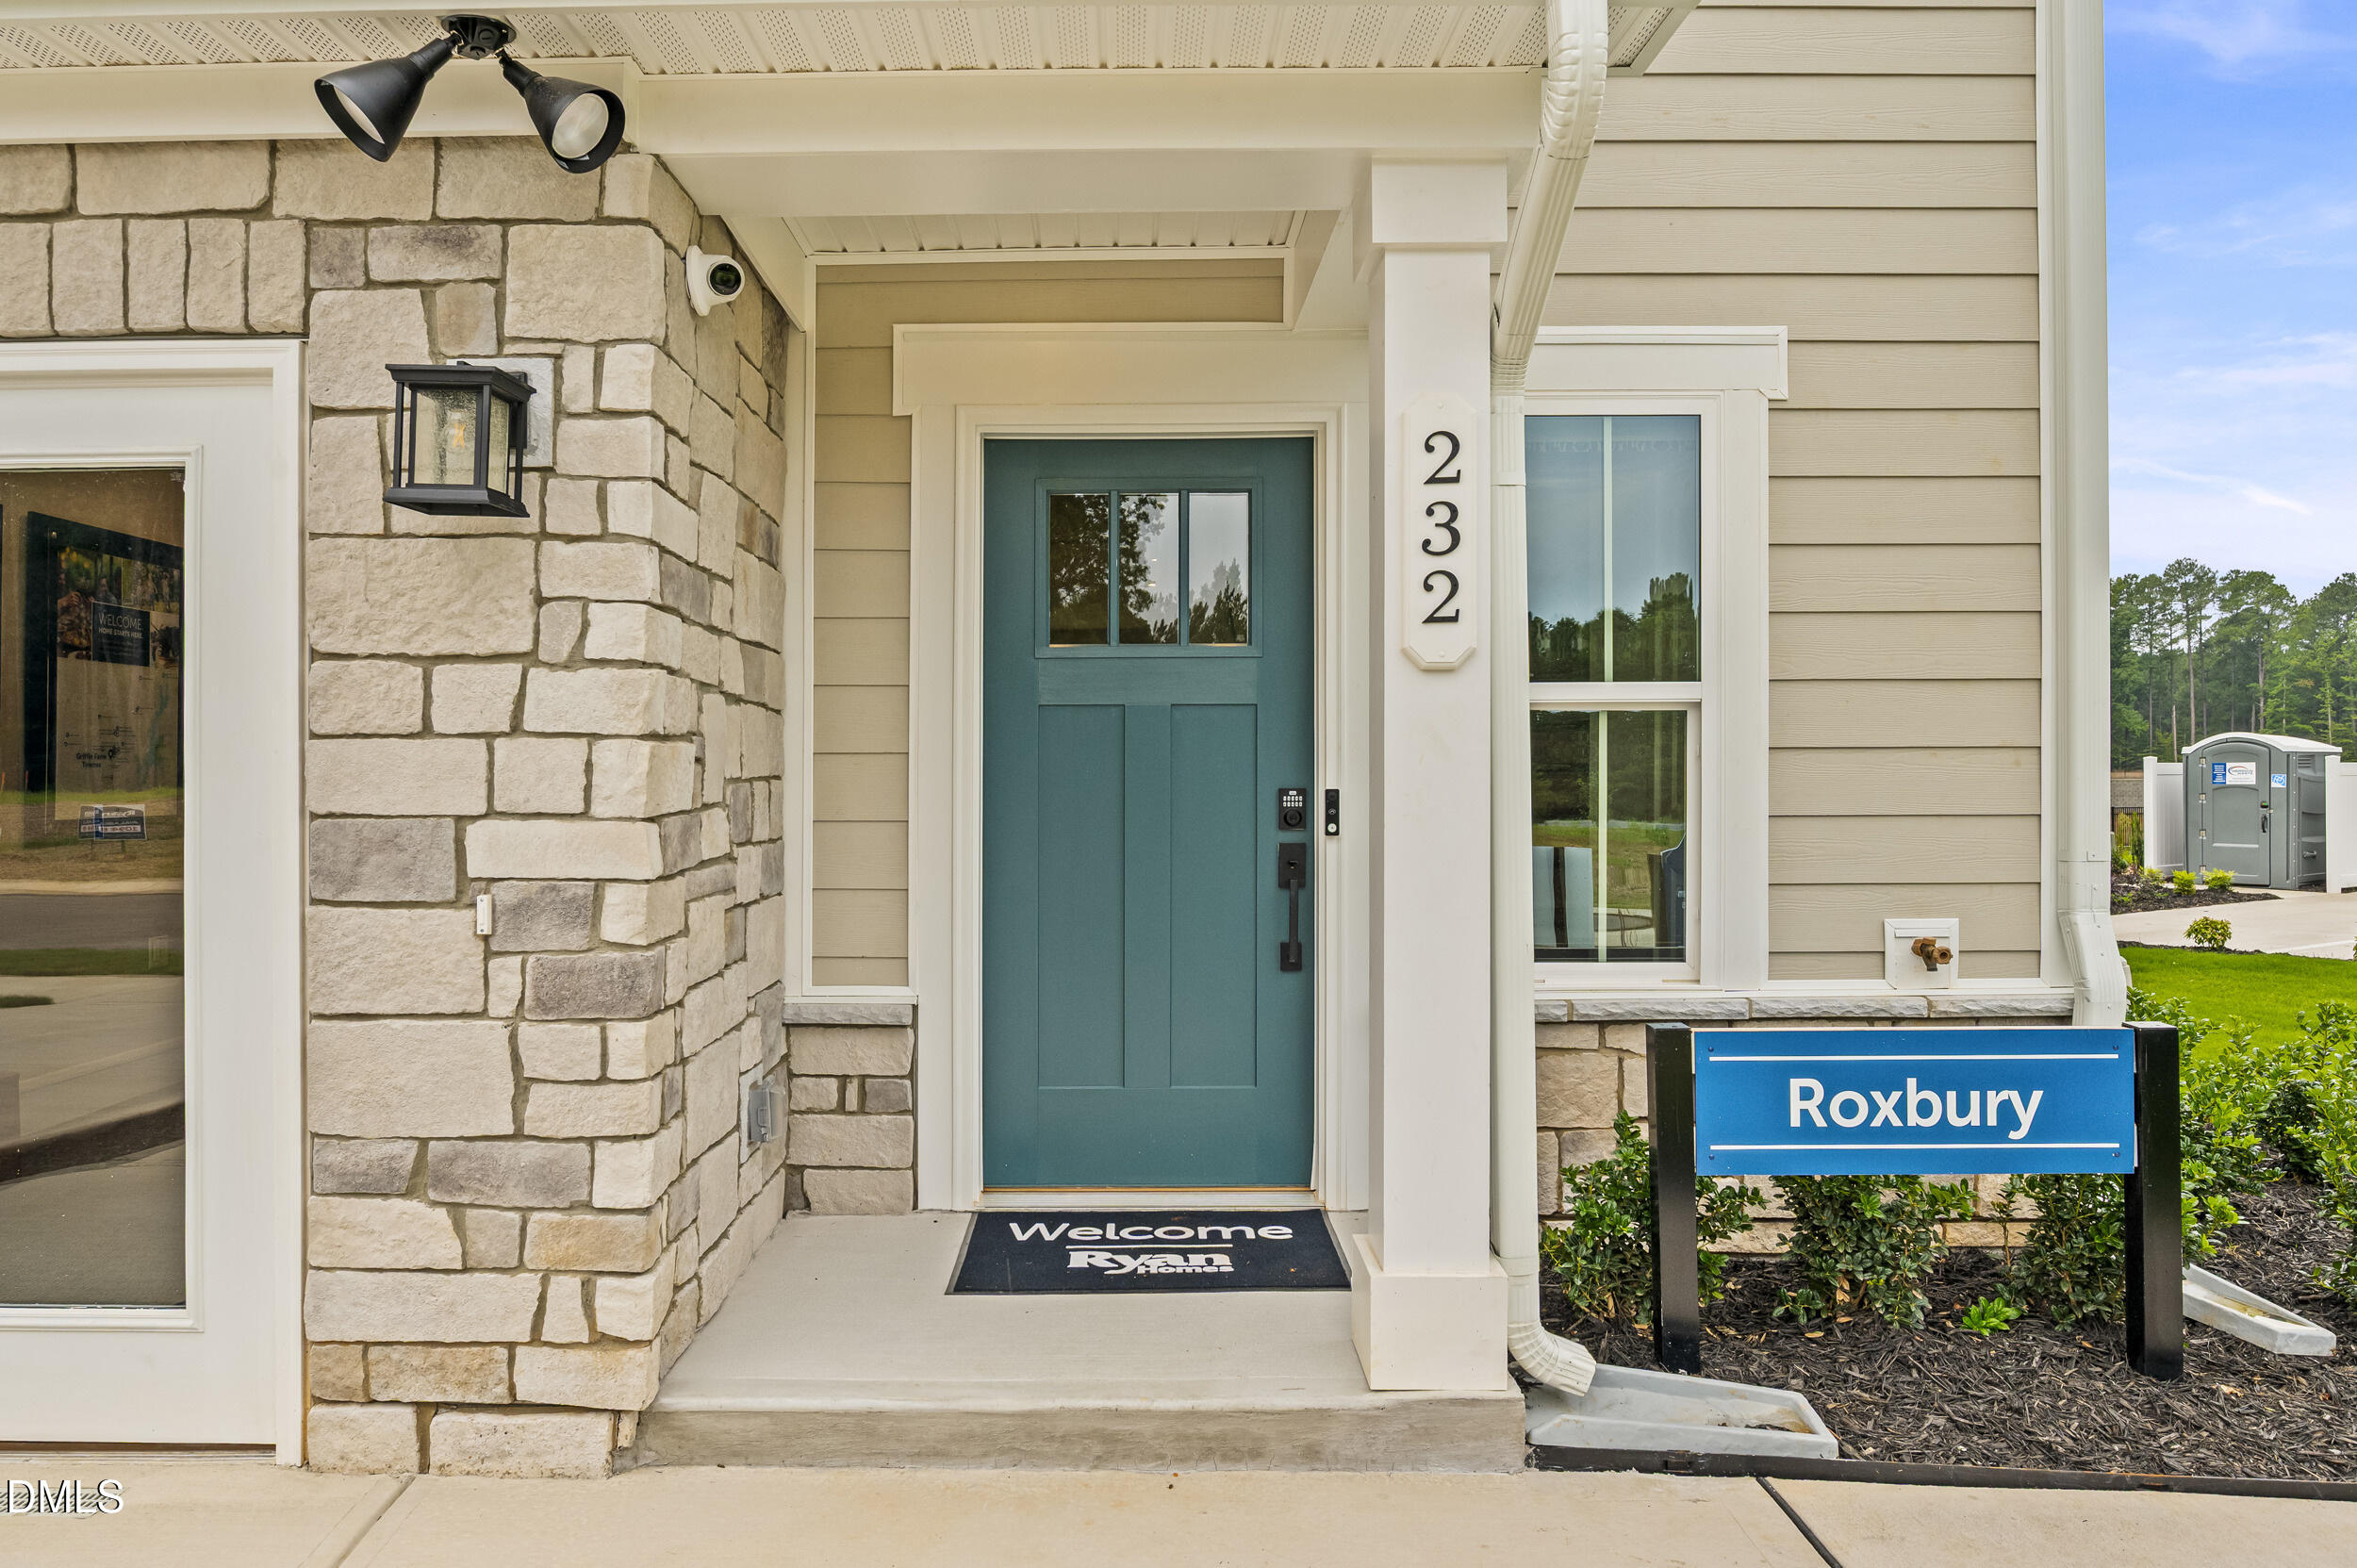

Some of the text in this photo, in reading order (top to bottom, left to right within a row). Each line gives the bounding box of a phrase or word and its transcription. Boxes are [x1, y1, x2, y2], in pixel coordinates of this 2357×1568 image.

[1422, 430, 1461, 624] 232
[1790, 1078, 2044, 1141] Roxbury
[1008, 1222, 1294, 1242] Welcome
[1066, 1250, 1231, 1275] Ryan
[1137, 1264, 1234, 1274] Homes
